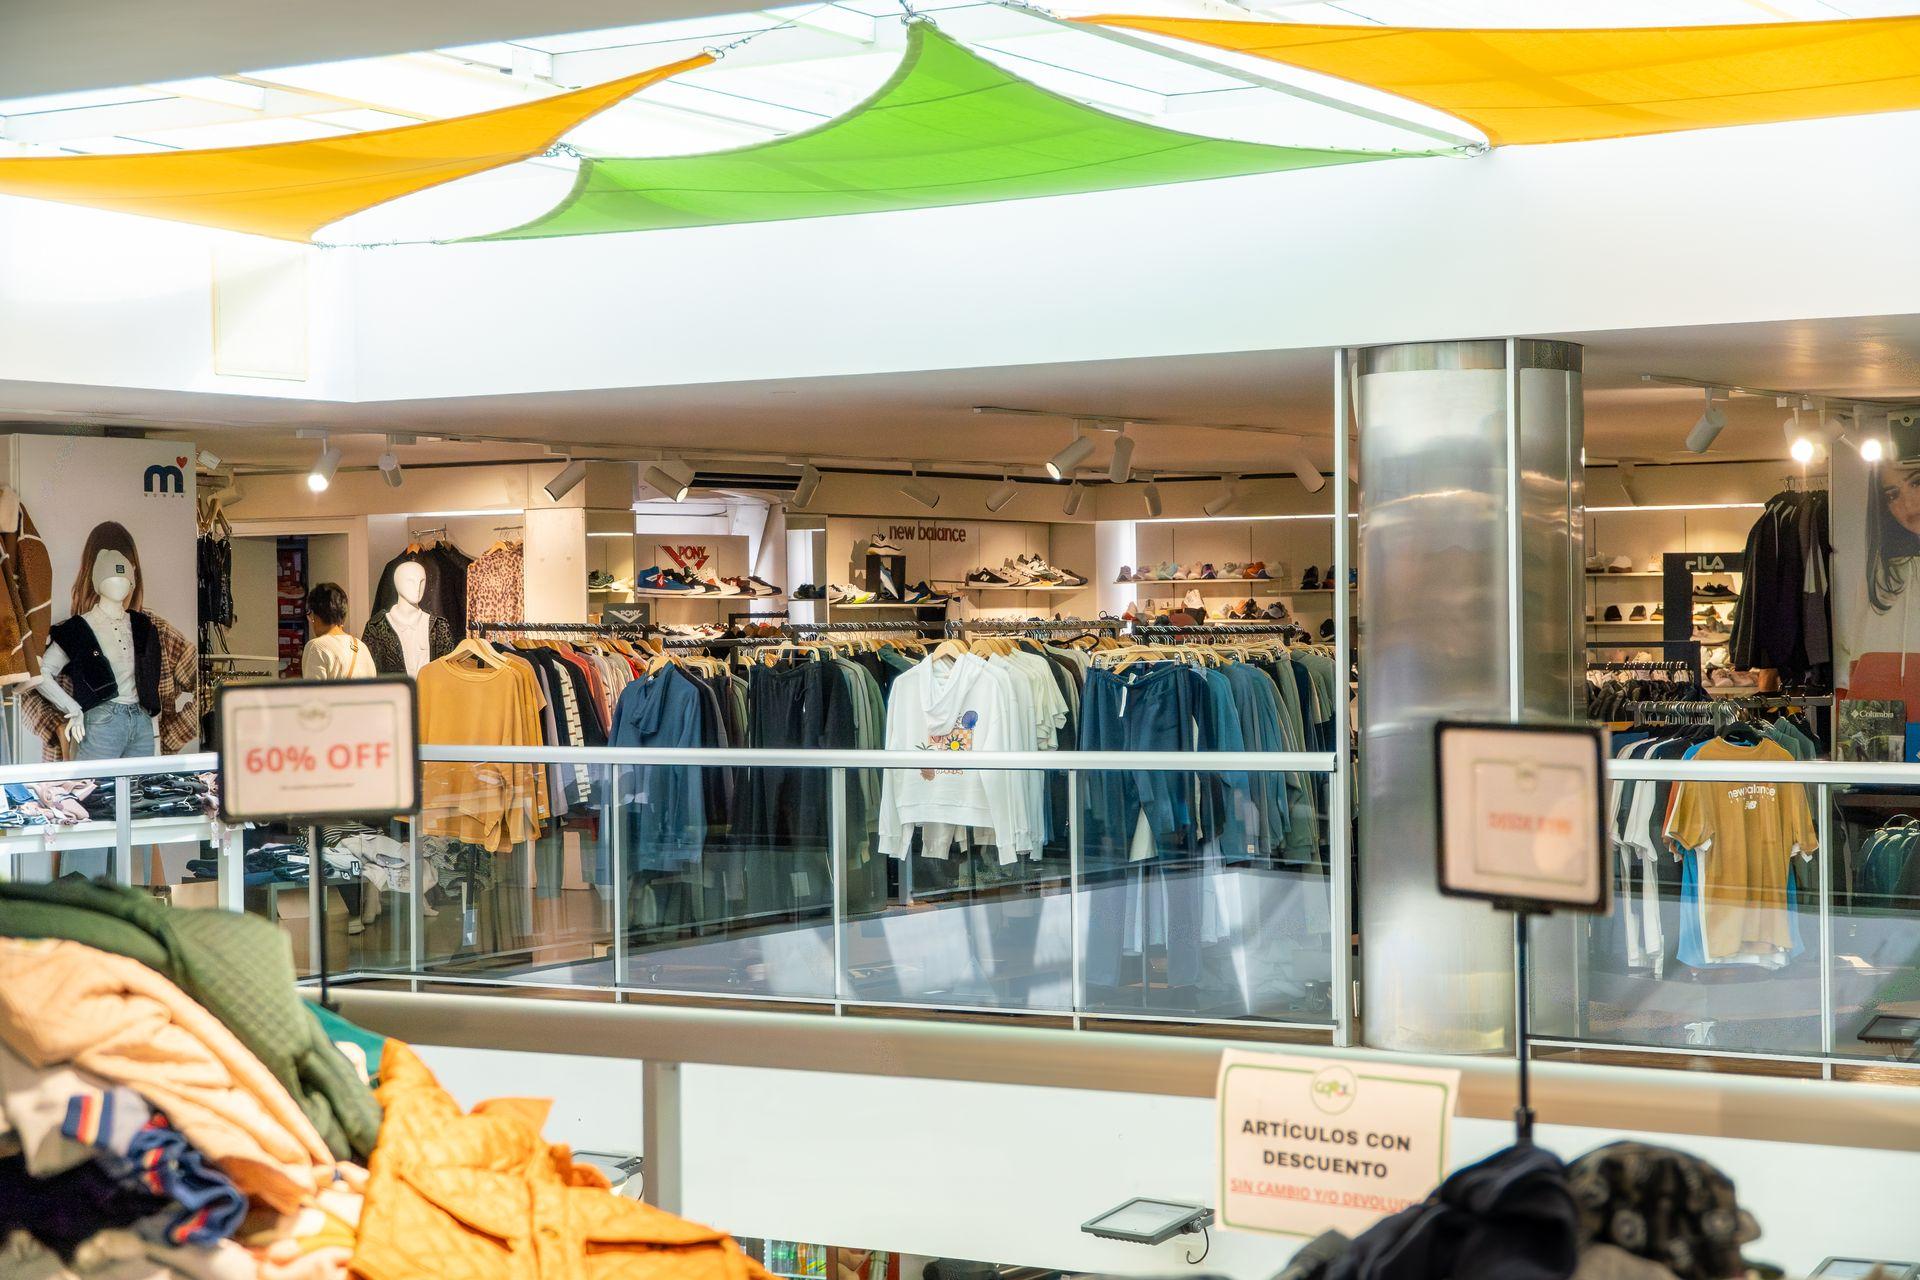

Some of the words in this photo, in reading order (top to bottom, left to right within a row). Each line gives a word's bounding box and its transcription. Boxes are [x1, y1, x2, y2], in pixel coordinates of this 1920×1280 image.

[889, 525, 915, 540] new
[918, 521, 966, 542] balance
[679, 545, 709, 559] PONY
[1685, 555, 1725, 570] FILA
[620, 609, 641, 617] PONY
[1860, 709, 1894, 718] Columbia
[246, 745, 316, 774] 60%
[327, 743, 391, 769] OFF
[1728, 787, 1744, 799] new
[1242, 1118, 1358, 1146] ARTÍCULOS
[1366, 1132, 1412, 1151] CON
[1263, 1150, 1388, 1178] DESCUENTO
[1231, 1177, 1252, 1193] SIN
[1257, 1181, 1311, 1200] CAMBIO
[1314, 1187, 1340, 1205] Y/O
